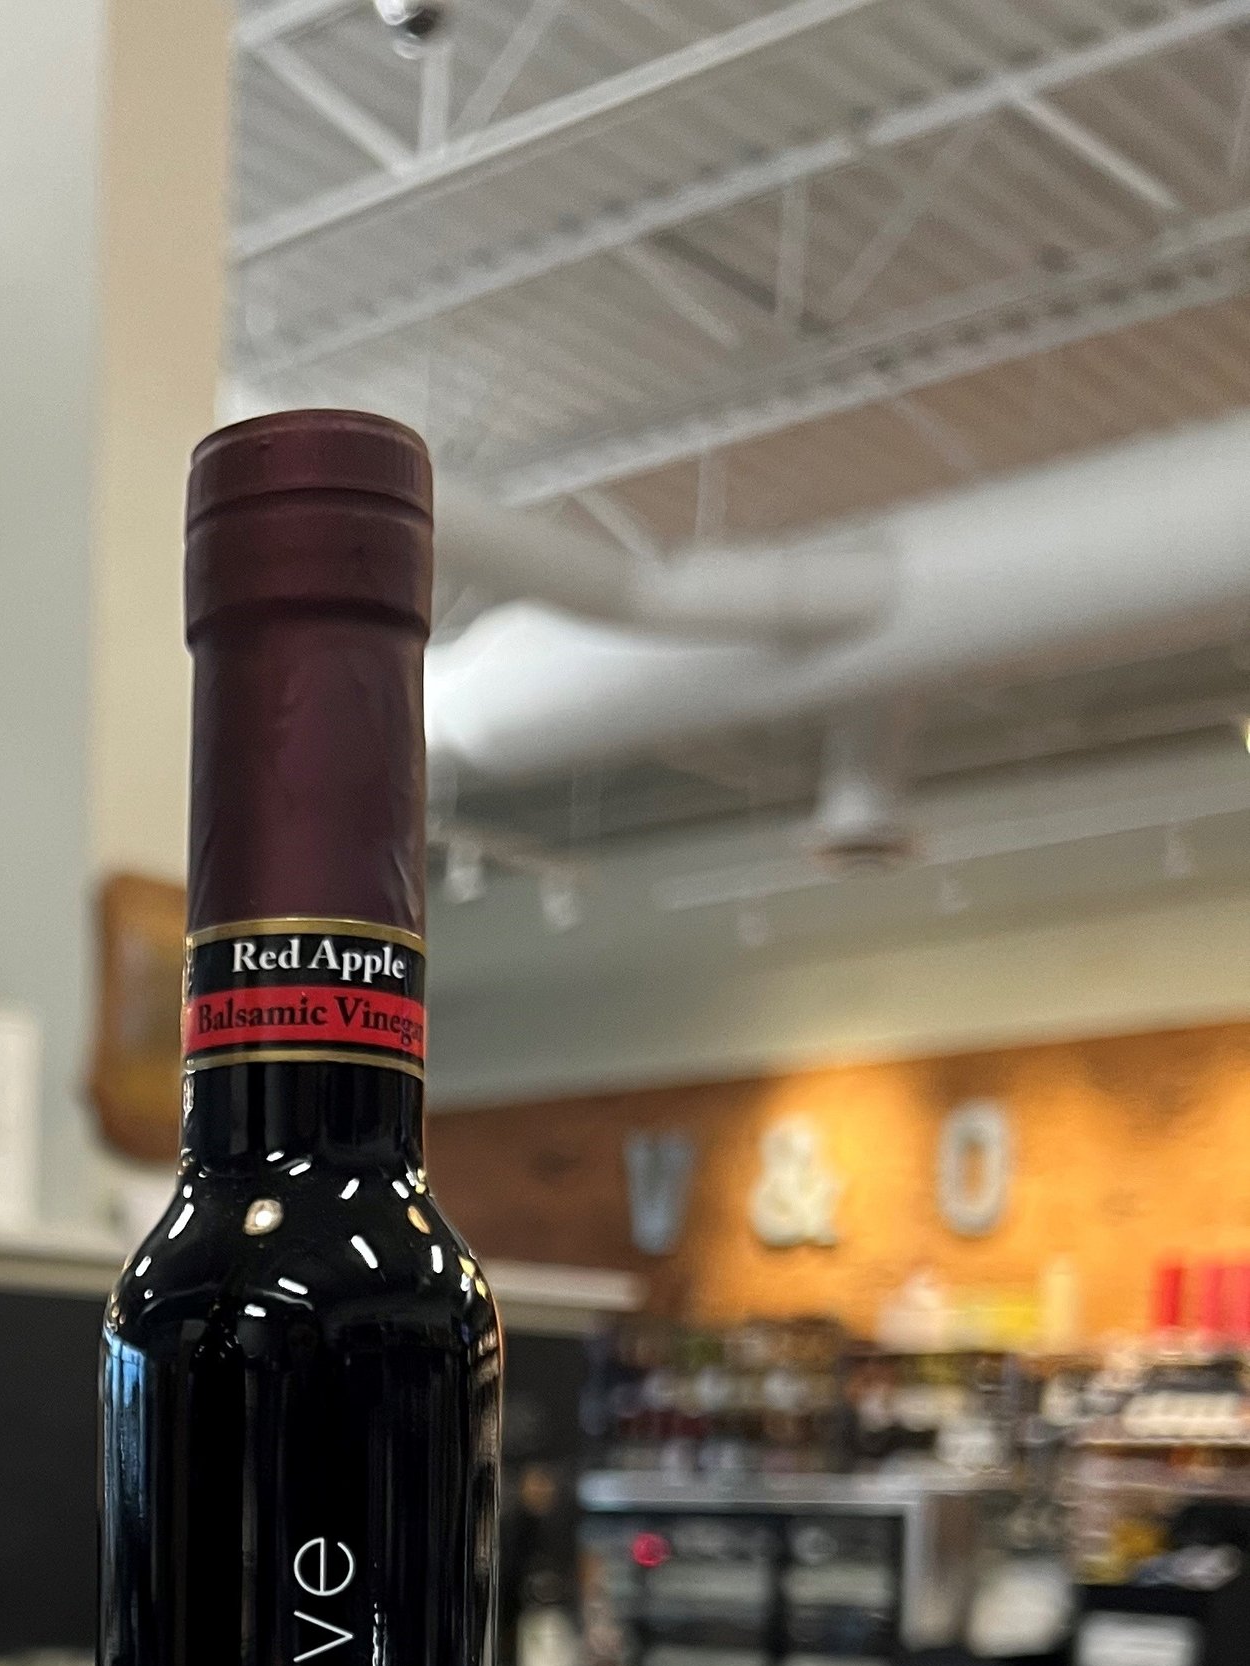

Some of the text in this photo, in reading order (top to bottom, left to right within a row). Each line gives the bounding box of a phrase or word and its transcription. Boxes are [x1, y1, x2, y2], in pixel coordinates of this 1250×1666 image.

[232, 938, 406, 984] Red Apple
[197, 997, 328, 1035] Balsamic
[752, 1110, 842, 1248] &
